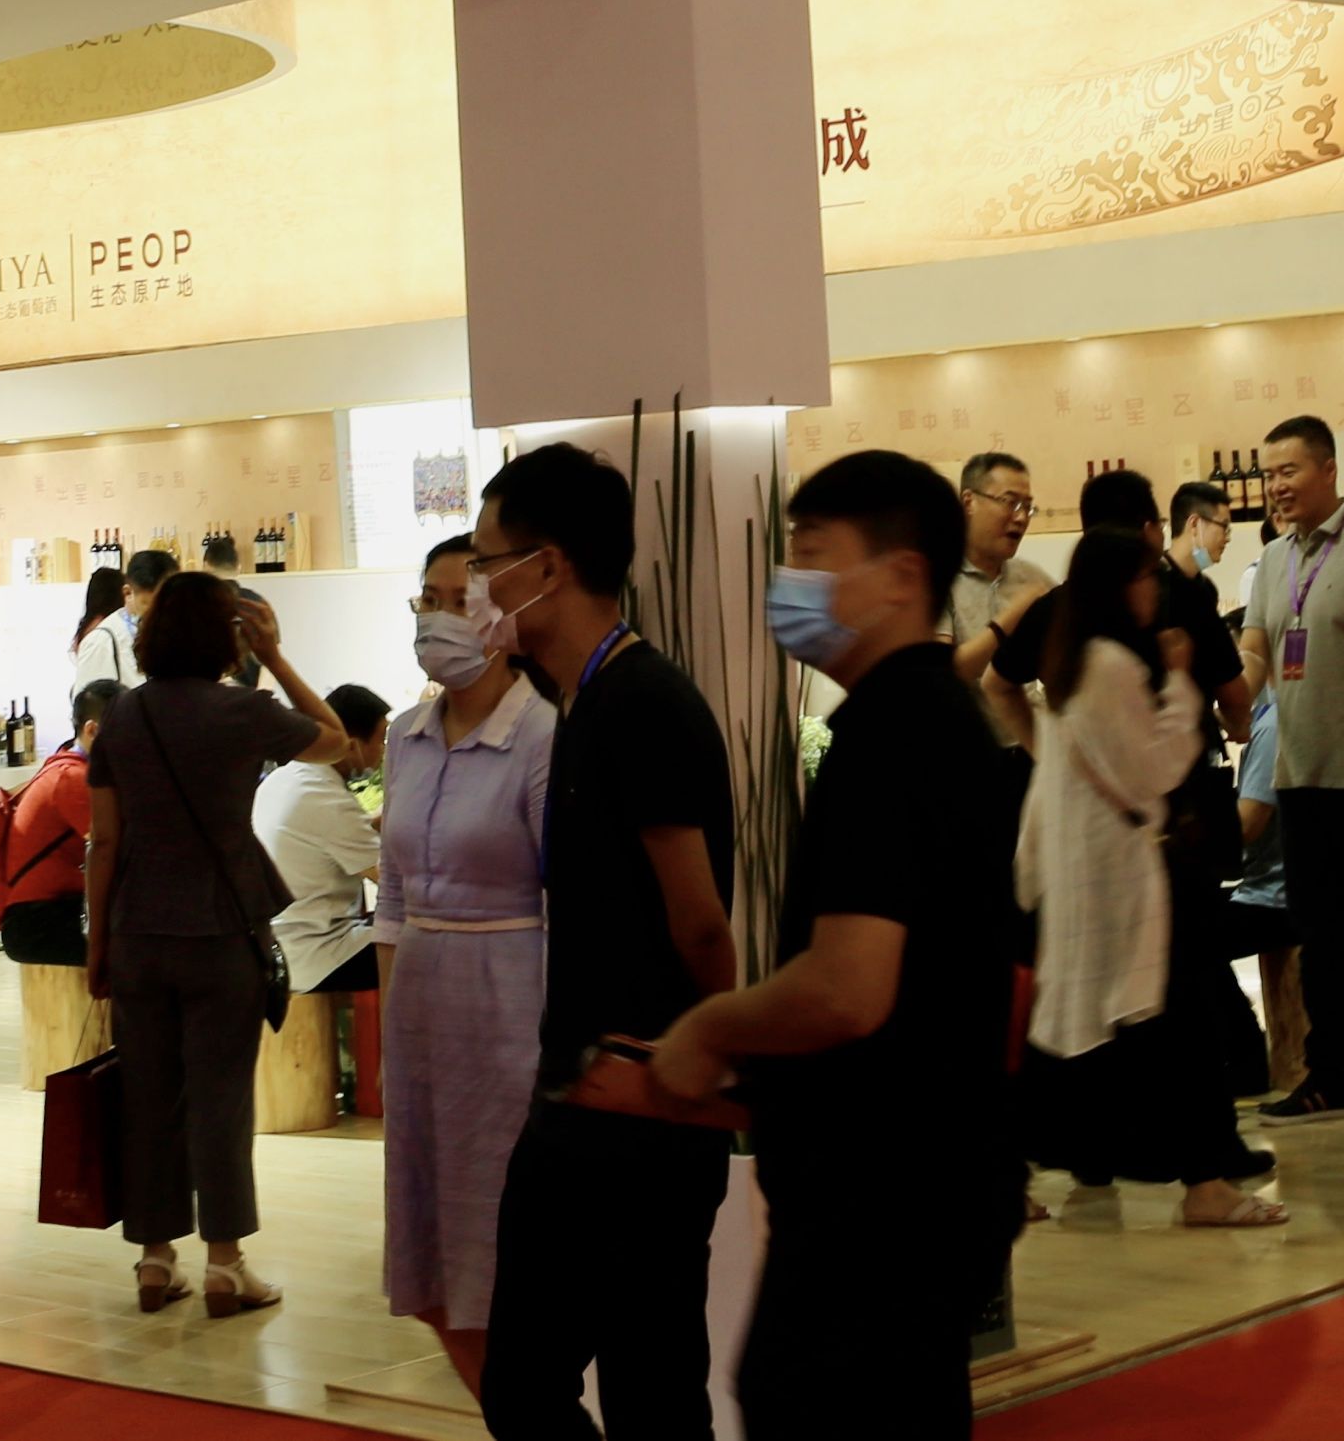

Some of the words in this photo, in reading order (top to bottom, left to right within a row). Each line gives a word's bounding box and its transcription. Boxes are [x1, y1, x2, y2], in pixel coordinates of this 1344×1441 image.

[821, 107, 871, 176] 成
[90, 229, 192, 275] PEOP
[89, 274, 193, 308] 生态原产地
